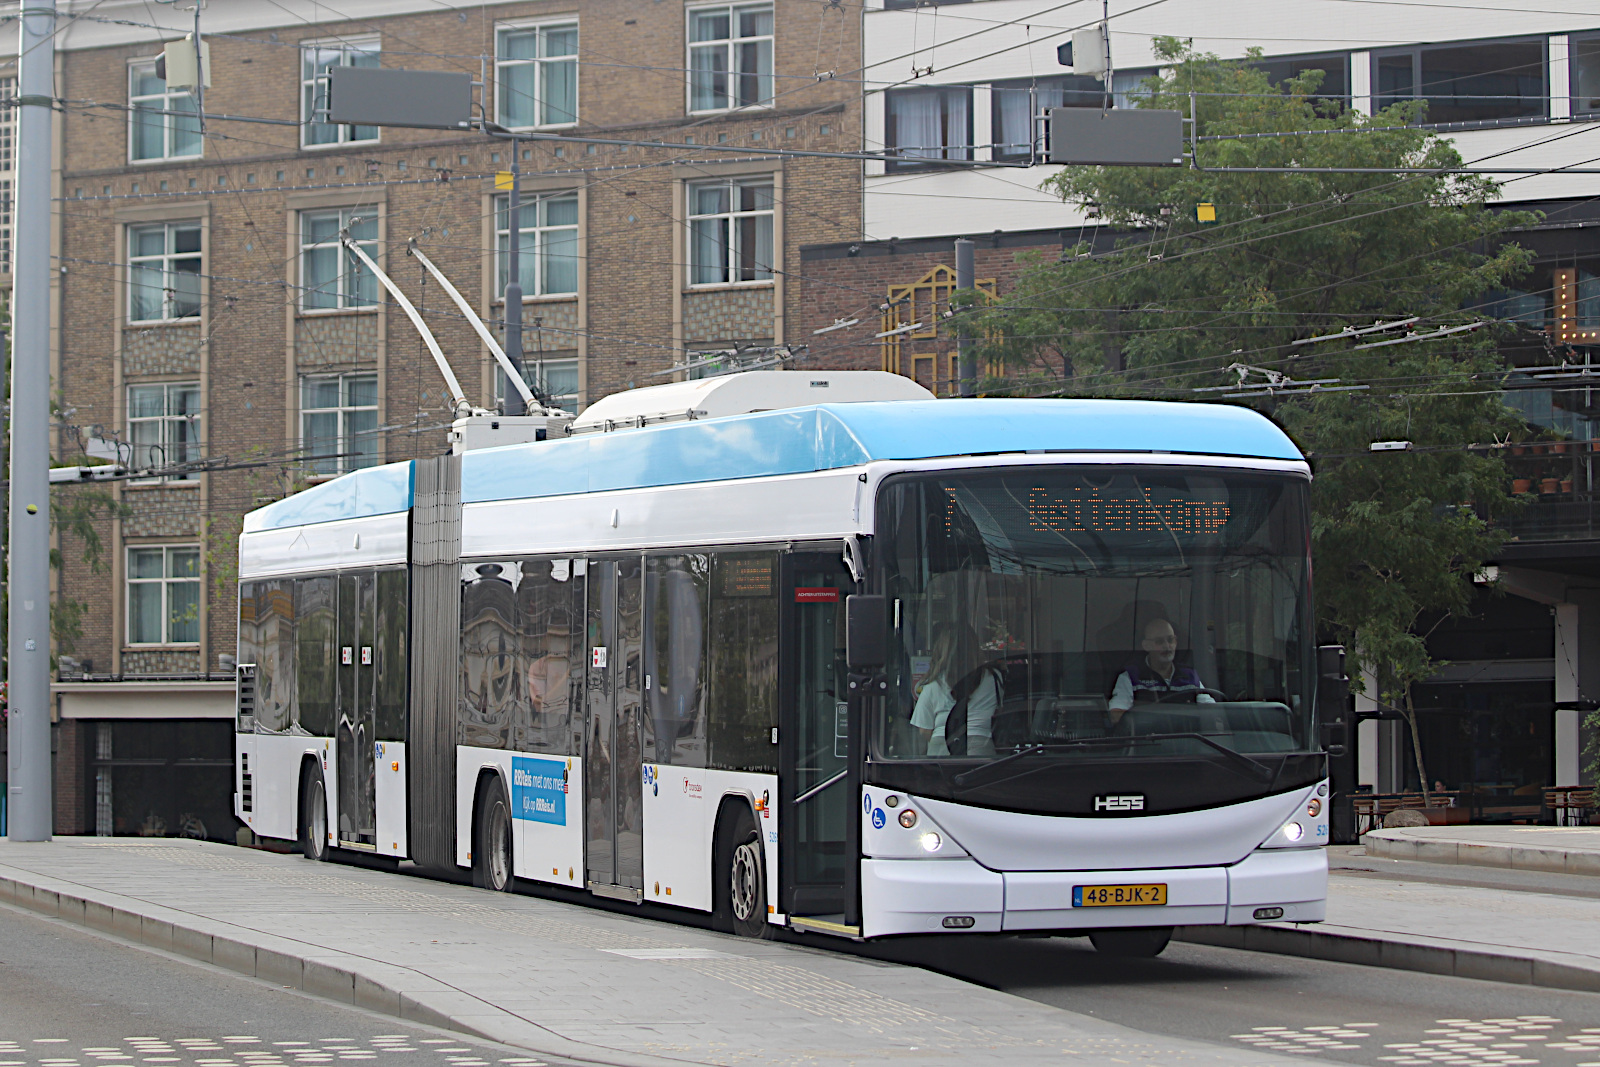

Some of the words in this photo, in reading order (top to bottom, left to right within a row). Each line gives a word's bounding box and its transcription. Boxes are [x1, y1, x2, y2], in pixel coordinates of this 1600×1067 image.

[1029, 487, 1230, 534] Geitenkamp
[514, 768, 532, 787] RRReis
[532, 774, 543, 788] met
[543, 777, 553, 789] ons
[1095, 795, 1144, 811] HESS
[1087, 886, 1160, 903] 48-BJK-2
